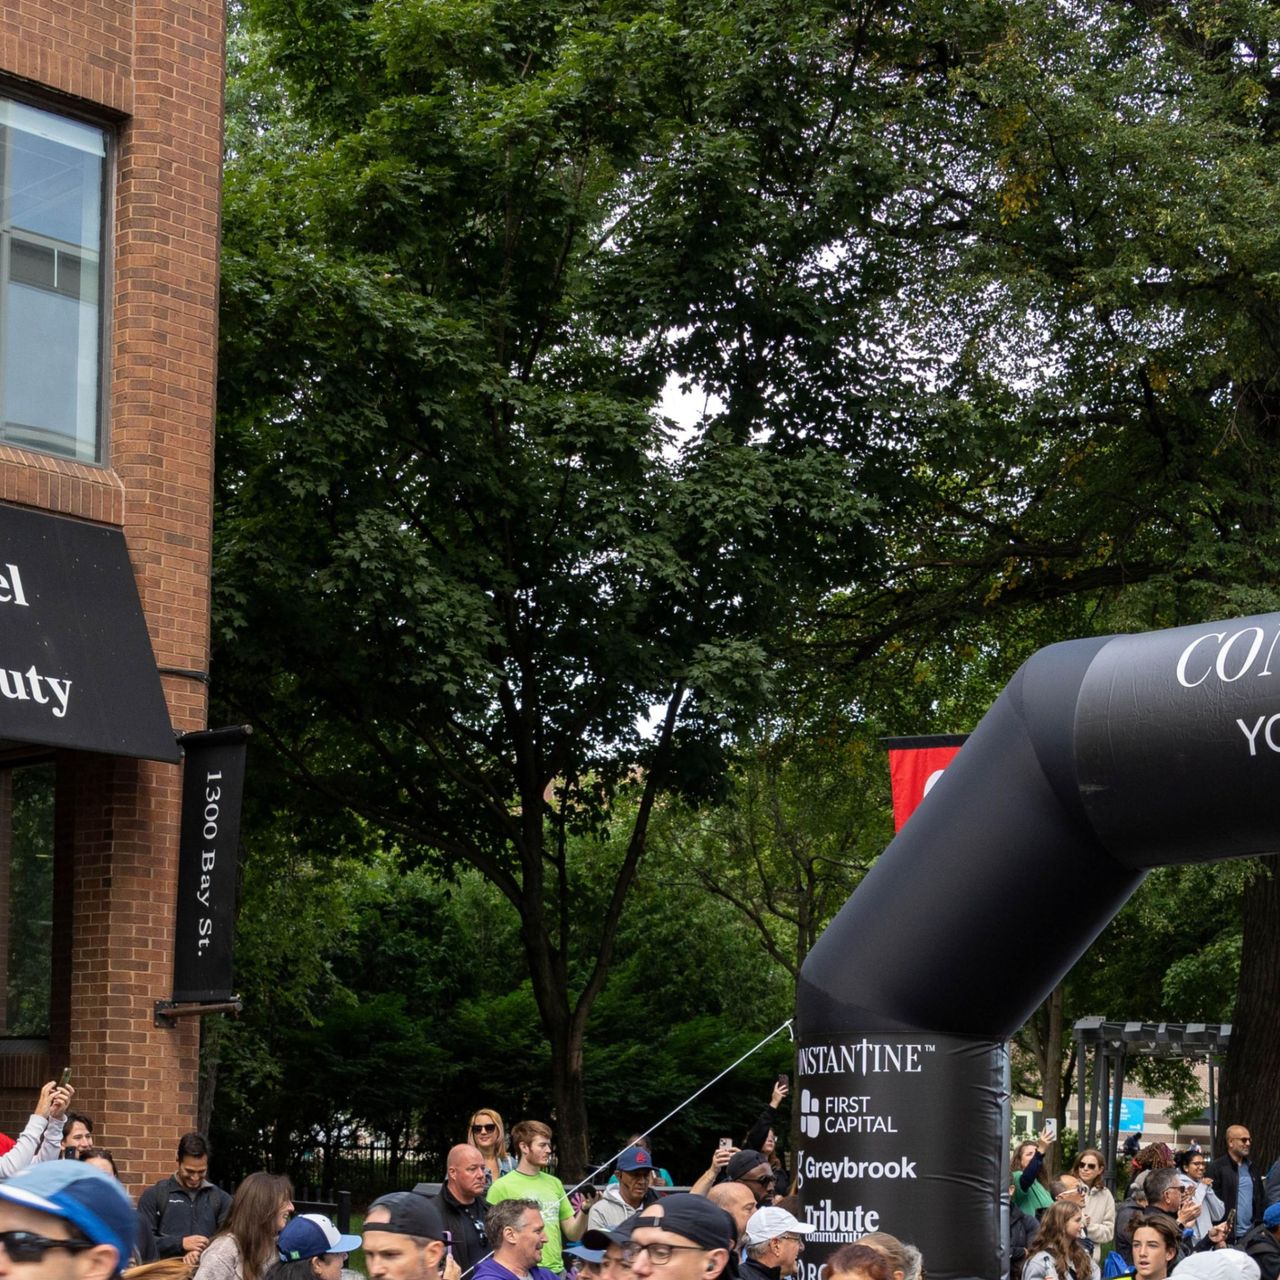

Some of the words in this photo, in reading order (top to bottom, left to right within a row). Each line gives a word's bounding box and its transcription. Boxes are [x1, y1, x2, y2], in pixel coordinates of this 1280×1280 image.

[203, 771, 222, 840] 1300
[196, 849, 216, 907] Bay
[198, 918, 212, 957] St.
[799, 1039, 922, 1076] NSTANTINE
[825, 1096, 871, 1113] FIRST
[825, 1116, 898, 1133] CAPITAL
[805, 1156, 917, 1183] Greybrook
[805, 1199, 880, 1232] Tribute
